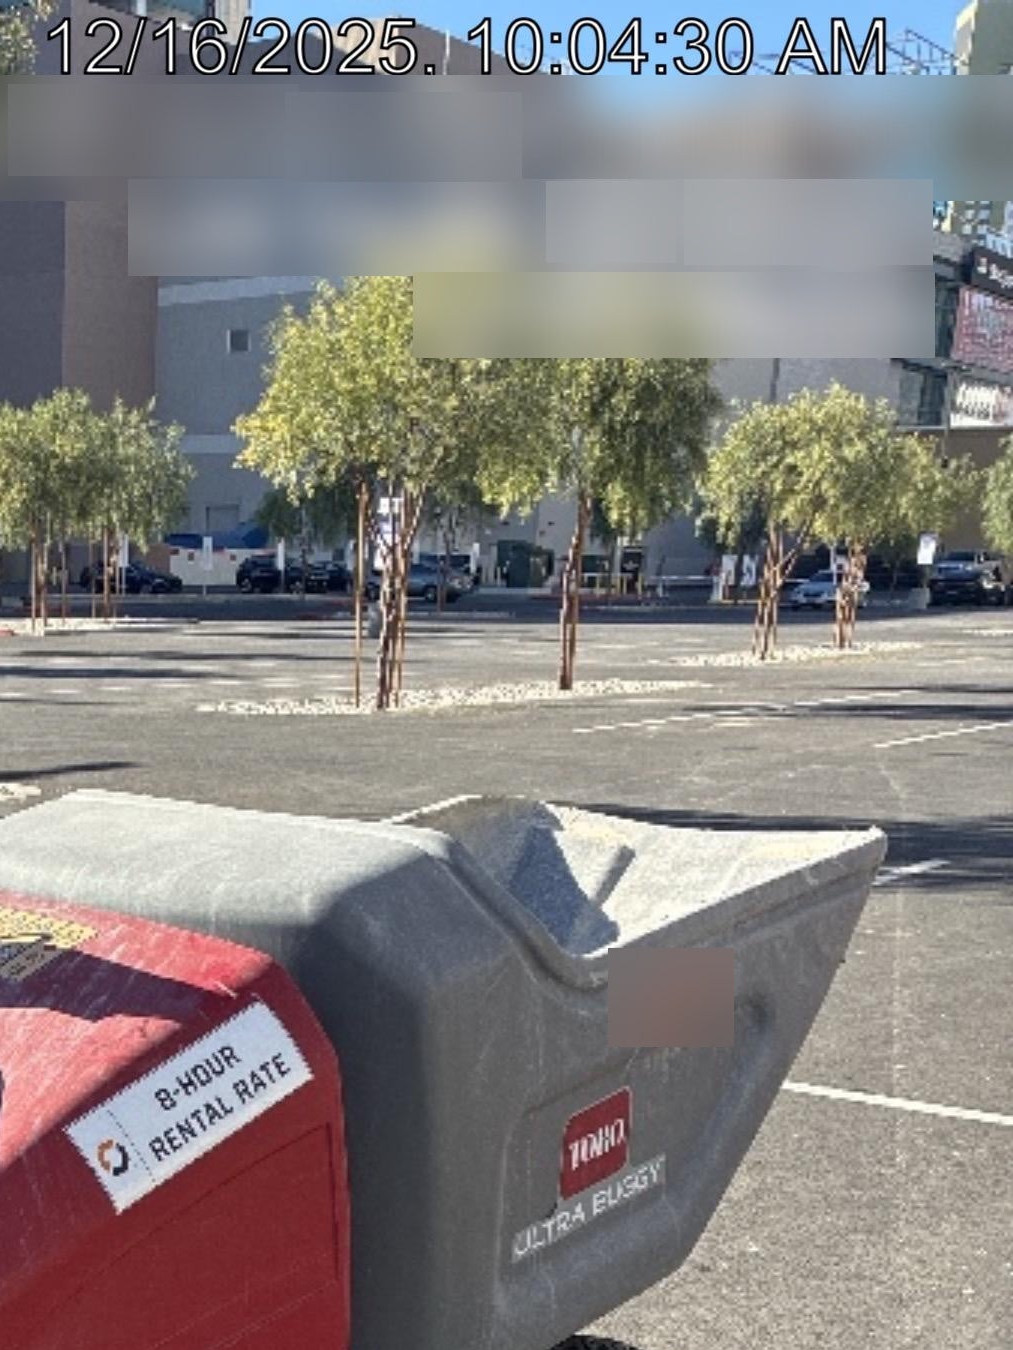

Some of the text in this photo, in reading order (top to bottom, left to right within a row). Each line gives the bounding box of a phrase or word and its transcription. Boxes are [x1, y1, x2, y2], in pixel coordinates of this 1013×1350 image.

[148, 1052, 292, 1162] RENTAL RATE
[154, 1045, 242, 1111] 8-HOUR
[568, 1118, 626, 1171] TORO
[513, 1153, 666, 1257] ULTRA BUGGY
